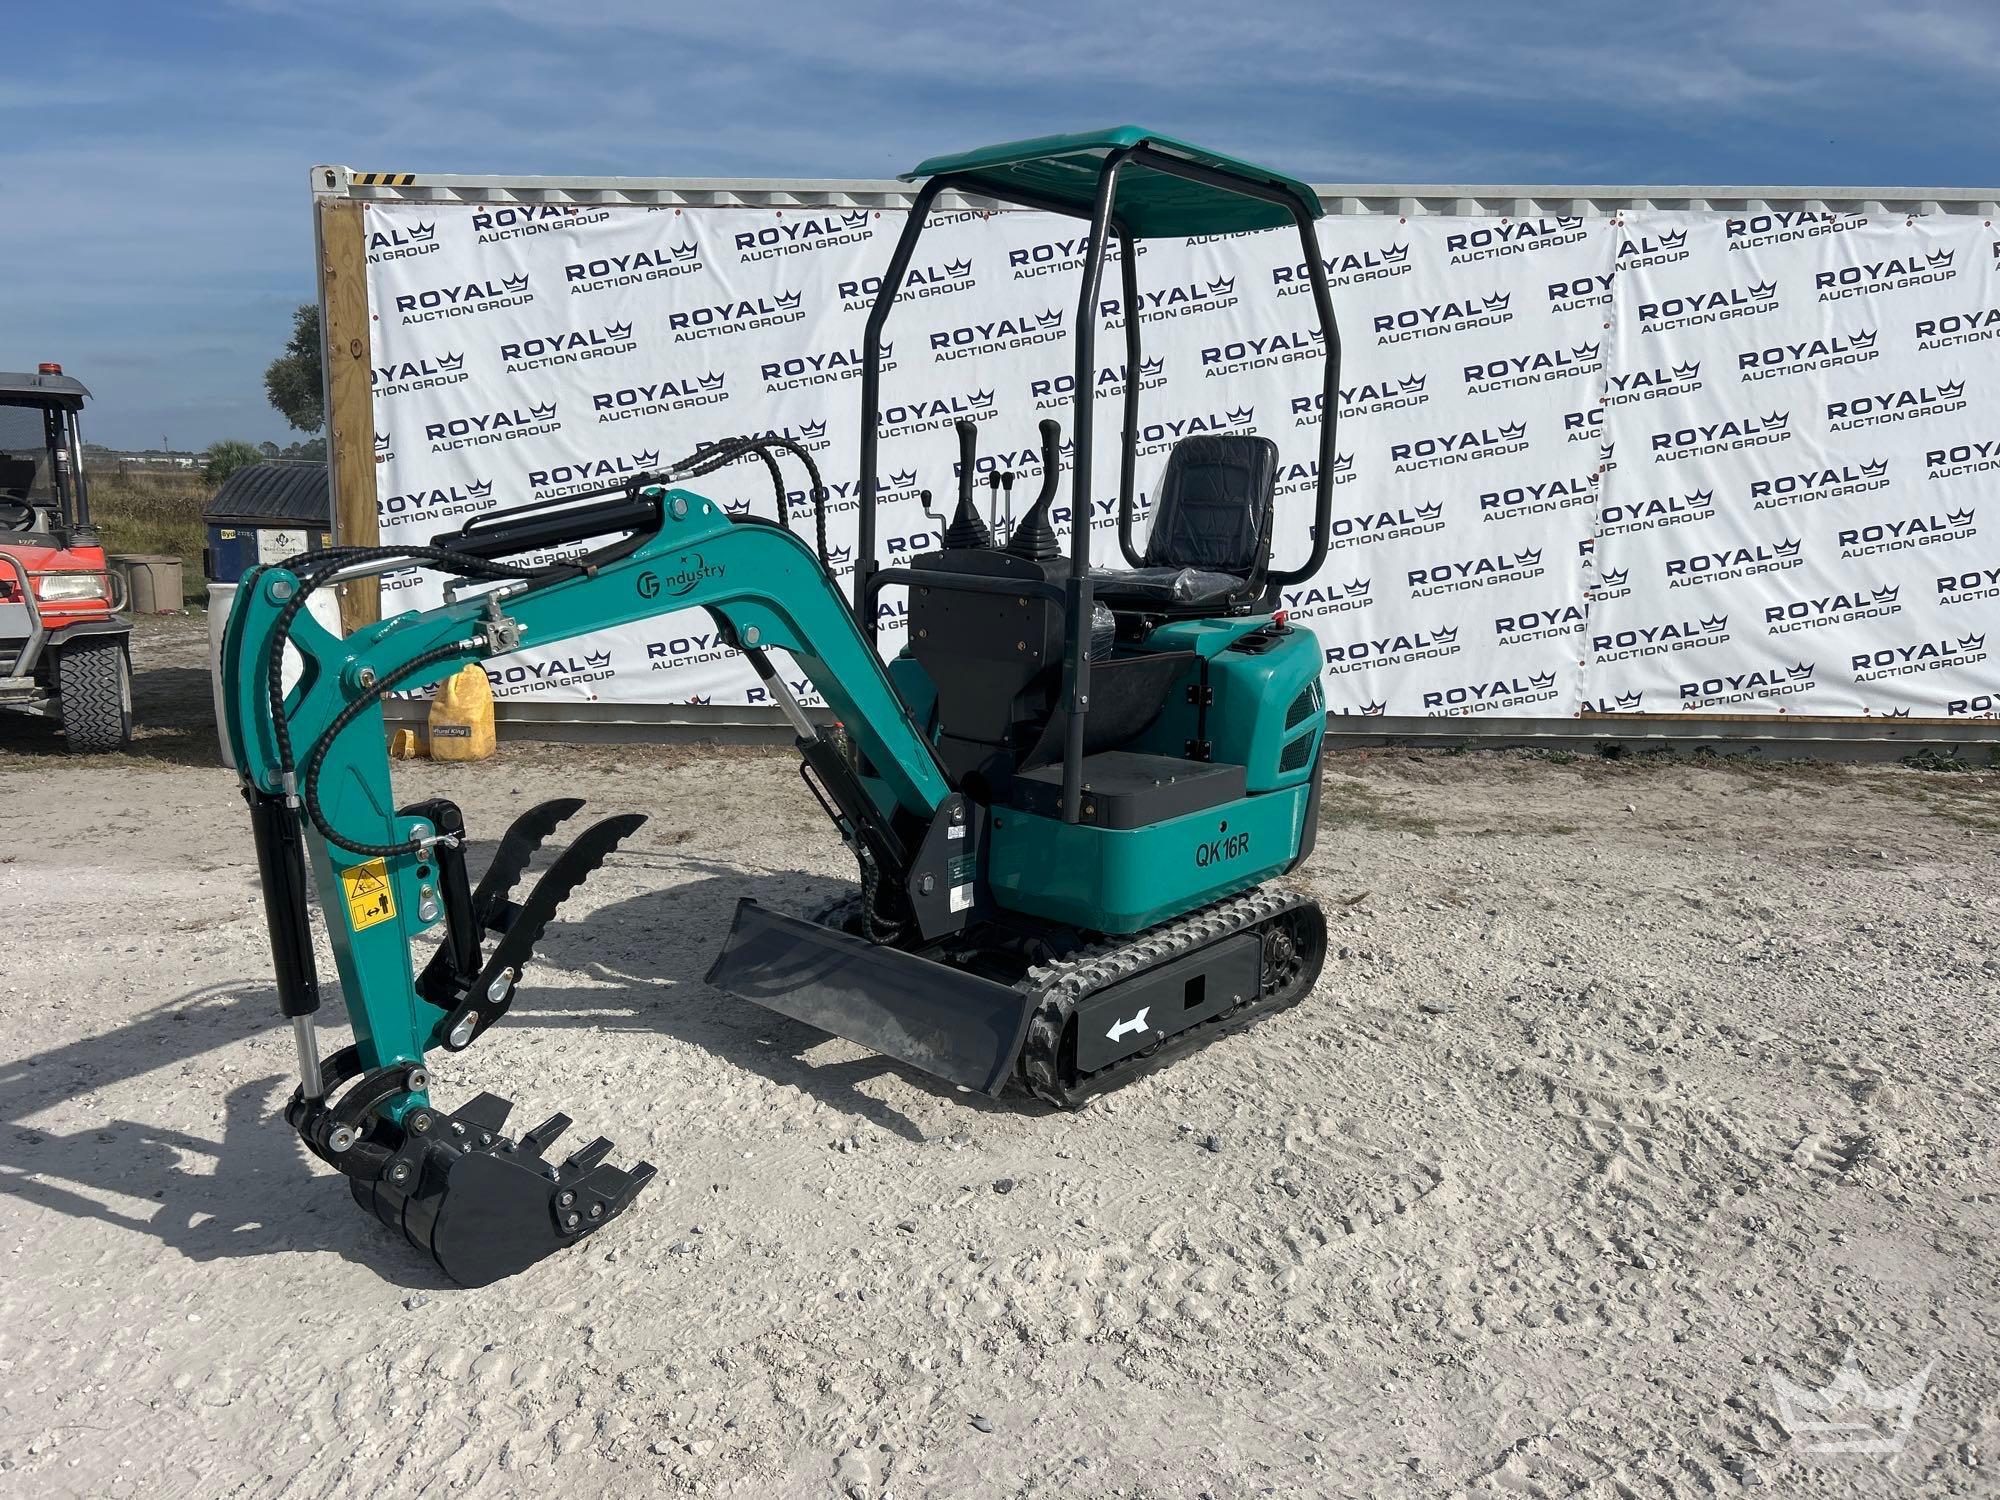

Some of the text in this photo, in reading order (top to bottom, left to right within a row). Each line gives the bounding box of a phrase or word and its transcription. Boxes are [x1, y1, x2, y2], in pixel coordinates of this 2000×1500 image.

[479, 212, 609, 244] AUCTION GROUP
[735, 219, 842, 250] ROYAL
[922, 210, 984, 230] UCTION
[741, 231, 872, 262] AUCTION GROUP
[1446, 220, 1556, 252] ROYAL
[1451, 233, 1586, 265] AUCTION GROUP
[1730, 219, 1867, 251] AUCTION GROUP
[384, 244, 438, 261] GROUP
[565, 251, 672, 281] ROYAL
[1631, 251, 1688, 268] GROUP
[572, 263, 702, 294] AUCTION GROUP
[838, 267, 945, 298] ROAL
[919, 280, 975, 296] GROUP
[1278, 265, 1411, 297] AUCON GROUP
[1816, 258, 1926, 289] ROYAL
[1819, 271, 1956, 302] AUCTION GROUP
[396, 282, 503, 312] ROYAL
[403, 295, 533, 325] AUCTION GROUP
[1552, 295, 1612, 313] AUCTIO
[1638, 290, 1748, 321] ROYAL
[669, 299, 775, 330] ROYAL
[675, 312, 805, 343] AUCTION GROUP
[1104, 298, 1237, 329] AUTION GROUP
[1374, 301, 1482, 332] ROYAL
[1642, 303, 1778, 334] AUCTION GROUP
[1915, 309, 2000, 338] ROYA
[930, 318, 1036, 349] ROYAL
[1379, 314, 1512, 345] AUCTION GROUP
[1918, 331, 1992, 351] AUCTION
[501, 330, 606, 361] ROYAL
[507, 343, 636, 373] AUCTION GROUP
[936, 331, 1065, 362] AUCTION GROUP
[1201, 333, 1308, 364] ROYAL
[1739, 338, 1848, 369] ROYAL
[761, 350, 863, 380] ROYAL
[1206, 347, 1327, 377] AUCTION GROU
[1464, 351, 1572, 382] ROYAL
[1743, 351, 1878, 382] AUCTION GROUP
[414, 374, 468, 390] GROUP
[767, 363, 897, 393] AUCTION GRUP
[1468, 364, 1602, 395] AUCTION GROUP
[1645, 383, 1702, 399] GROUP
[593, 380, 699, 410] ROYAL
[600, 393, 728, 423] AUCTION GROUP
[1372, 396, 1428, 412] GROUP
[1827, 389, 1936, 419] ROYAL
[425, 411, 531, 440] ROYAL
[877, 421, 938, 438] UCTION
[1831, 401, 1966, 432] AUCTION GROUP
[432, 423, 560, 453] AUCTION GROUP
[1391, 430, 1499, 461] ROYAL
[1651, 420, 1760, 450] ROYAL
[1655, 433, 1790, 463] AUCTION GROUP
[529, 458, 633, 487] ROYAL
[1396, 443, 1528, 473] AUCTION GROUP
[1929, 460, 2000, 480] AUCTION
[535, 480, 604, 500] AUCTION
[1300, 473, 1357, 491] GRUP
[1480, 479, 1587, 509] ROYAL
[1751, 467, 1859, 497] ROYAL
[1755, 480, 1889, 510] AUCTION GROUP
[877, 490, 920, 504] ROUP
[1484, 502, 1556, 521] AUCTION
[1601, 498, 1685, 524] OYAL
[379, 500, 496, 527] UCTION GROUP
[1308, 510, 1415, 539] OYAL
[1595, 510, 1714, 537] UCTION GROUP
[1327, 522, 1444, 549] UCTION GROUP
[1839, 517, 1946, 546] ROYAL
[1842, 529, 1976, 559] AUCTION GROUP
[1408, 556, 1514, 586] ROYAL
[1666, 547, 1773, 576] ROYAL
[1670, 559, 1802, 588] AUCTION GROUP
[380, 577, 423, 592] ROUP
[1412, 569, 1544, 598] AUCTION GROUP
[1589, 588, 1631, 602] ROUP
[1940, 589, 2000, 606] AUCTIO
[1317, 599, 1372, 615] GROUP
[1765, 593, 1871, 622] ROYAL
[1769, 606, 1900, 635] AUCTION GROUP
[1325, 634, 1431, 663] ROYAL
[1499, 627, 1570, 646] AUCTION
[1593, 623, 1700, 651] ROYAL
[1596, 635, 1729, 664] AUCTION GROUP
[652, 651, 720, 670] AUCTION
[1330, 646, 1460, 675] AUCTION GROUP
[1851, 641, 1957, 670] ROYAL
[1855, 654, 1986, 683] AUCTION GROUP
[561, 671, 614, 686] GROUP
[1680, 671, 1786, 699] ROYAL
[1423, 680, 1528, 708] ROYAL
[1502, 692, 1557, 707] GROUP
[1683, 682, 1815, 711] AUCTION GROUP
[451, 728, 465, 736] King
